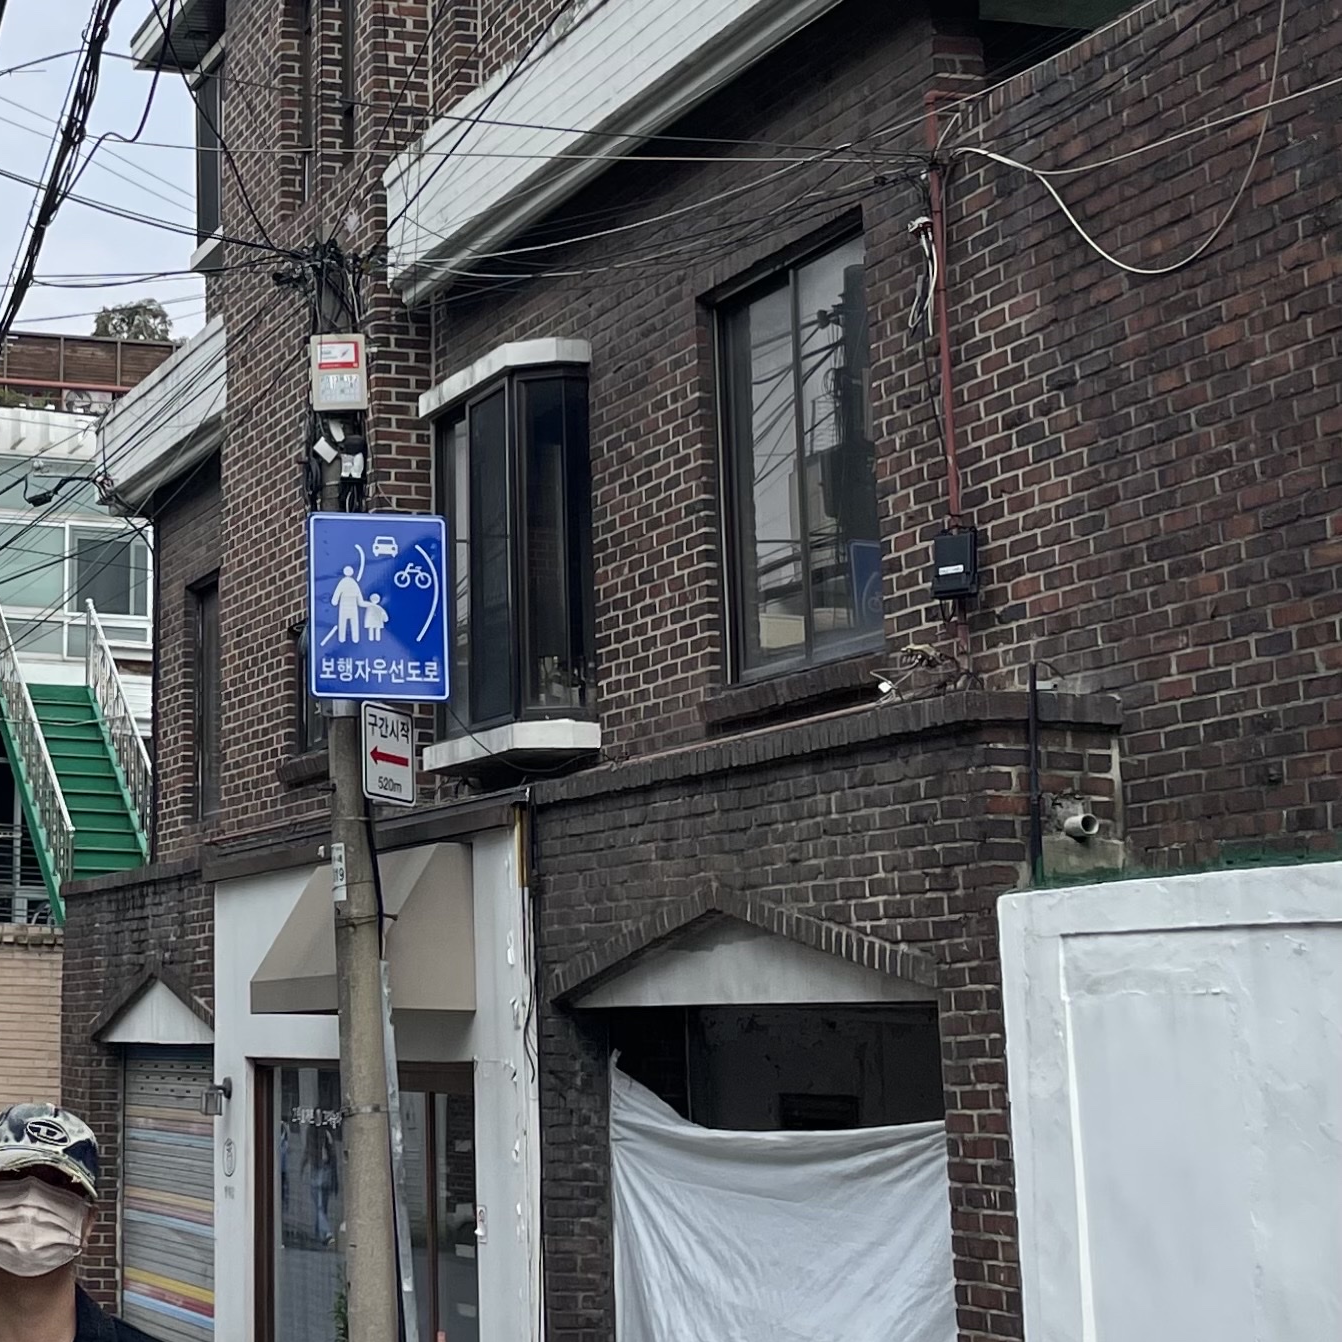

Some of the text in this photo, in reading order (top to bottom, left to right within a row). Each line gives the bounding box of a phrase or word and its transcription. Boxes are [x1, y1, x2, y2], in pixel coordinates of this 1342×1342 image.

[319, 657, 441, 683] 보행자우선도로
[367, 713, 410, 745] 구간시작
[377, 775, 403, 794] 520m
